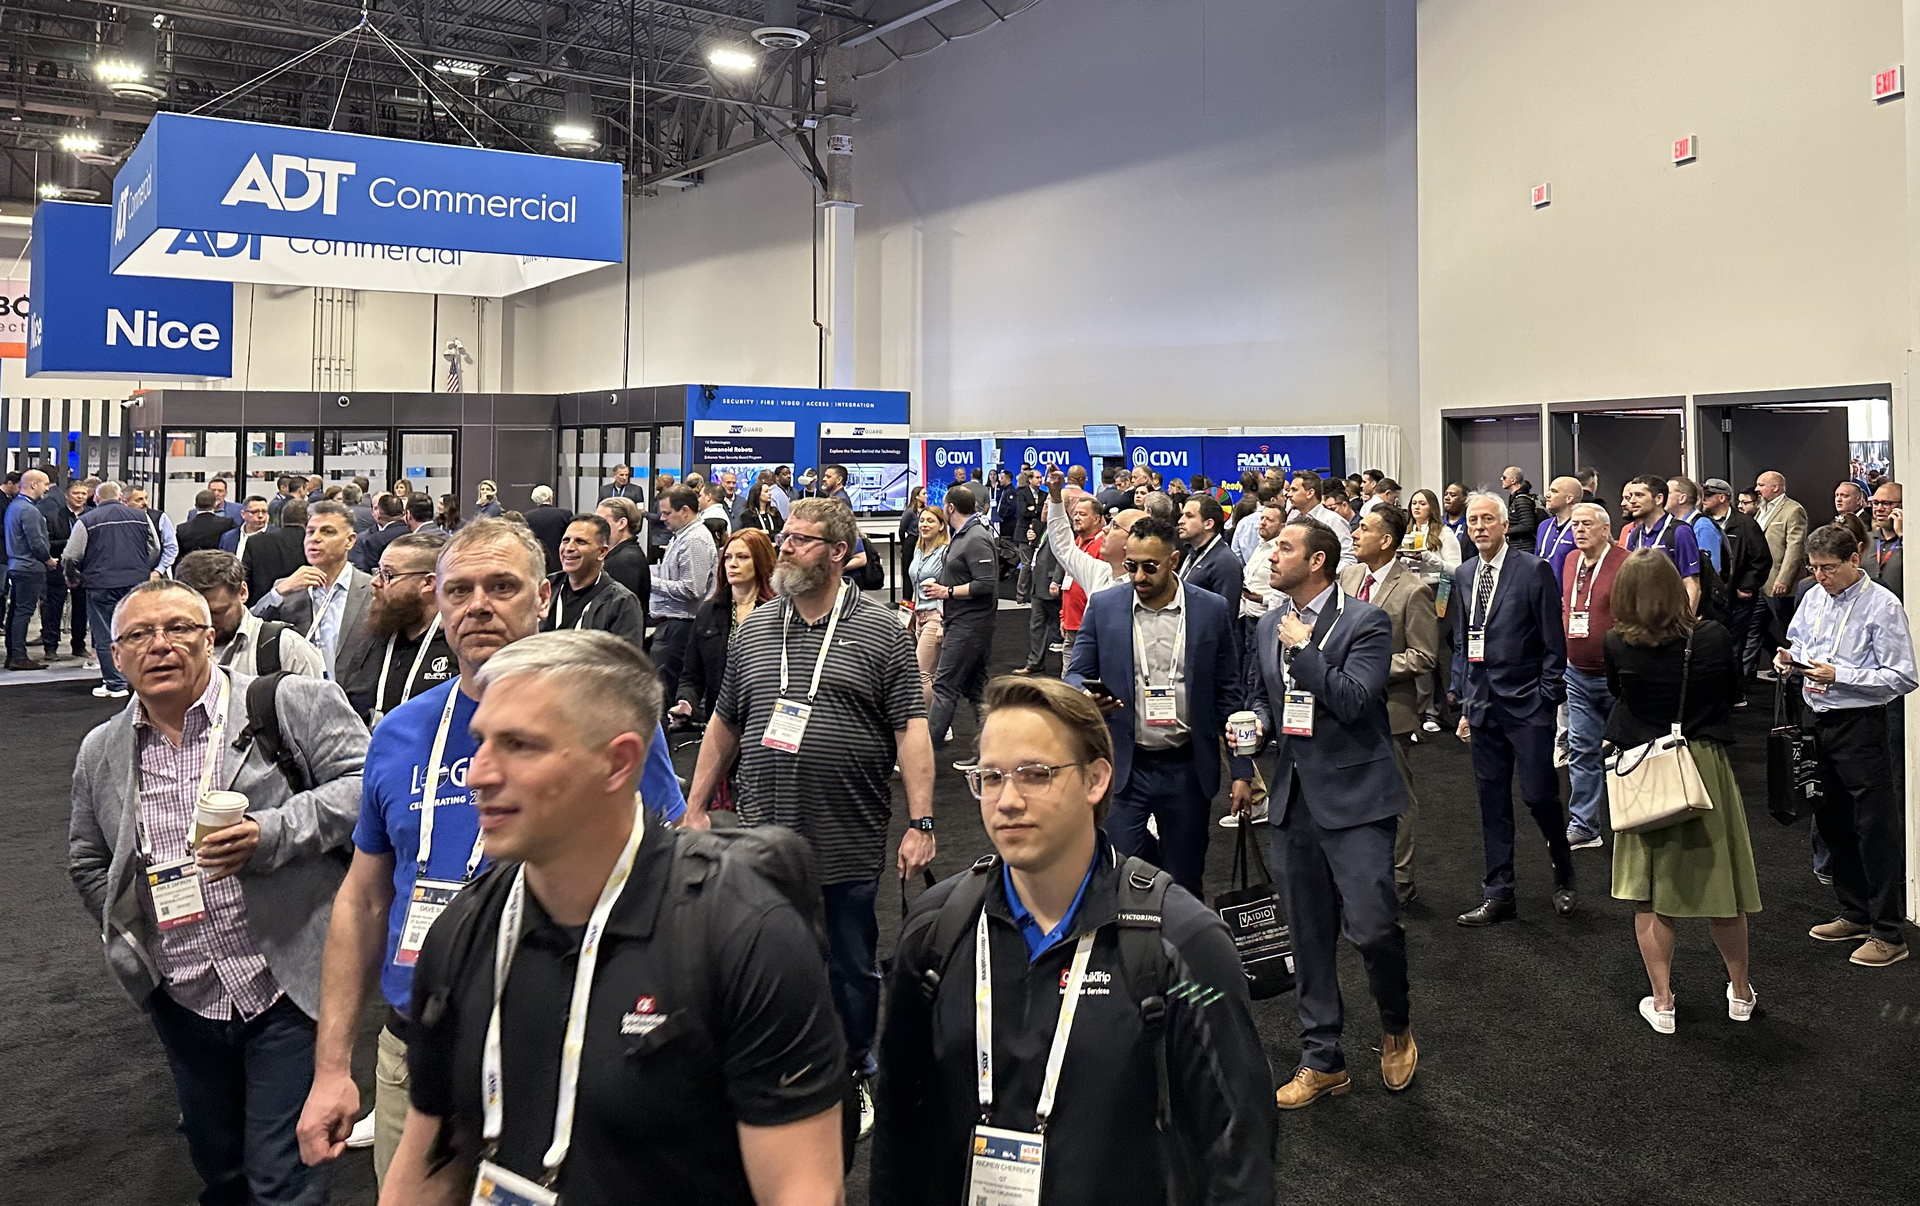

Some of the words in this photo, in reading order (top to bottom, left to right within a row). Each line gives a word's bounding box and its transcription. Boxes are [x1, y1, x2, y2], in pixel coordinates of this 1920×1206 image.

[1876, 70, 1895, 95] EXIT
[1675, 138, 1688, 159] EXIT
[221, 152, 356, 215] ADT
[369, 177, 577, 224] Commercial
[106, 308, 220, 351] Nice
[947, 451, 974, 464] CDVI
[1038, 451, 1069, 465] CDVI
[1151, 450, 1188, 466] CDVI
[1221, 480, 1243, 493] Ready
[409, 795, 467, 811] CELRATING
[1122, 914, 1162, 923] VICTORINOX
[1241, 909, 1271, 924] VAIDIO
